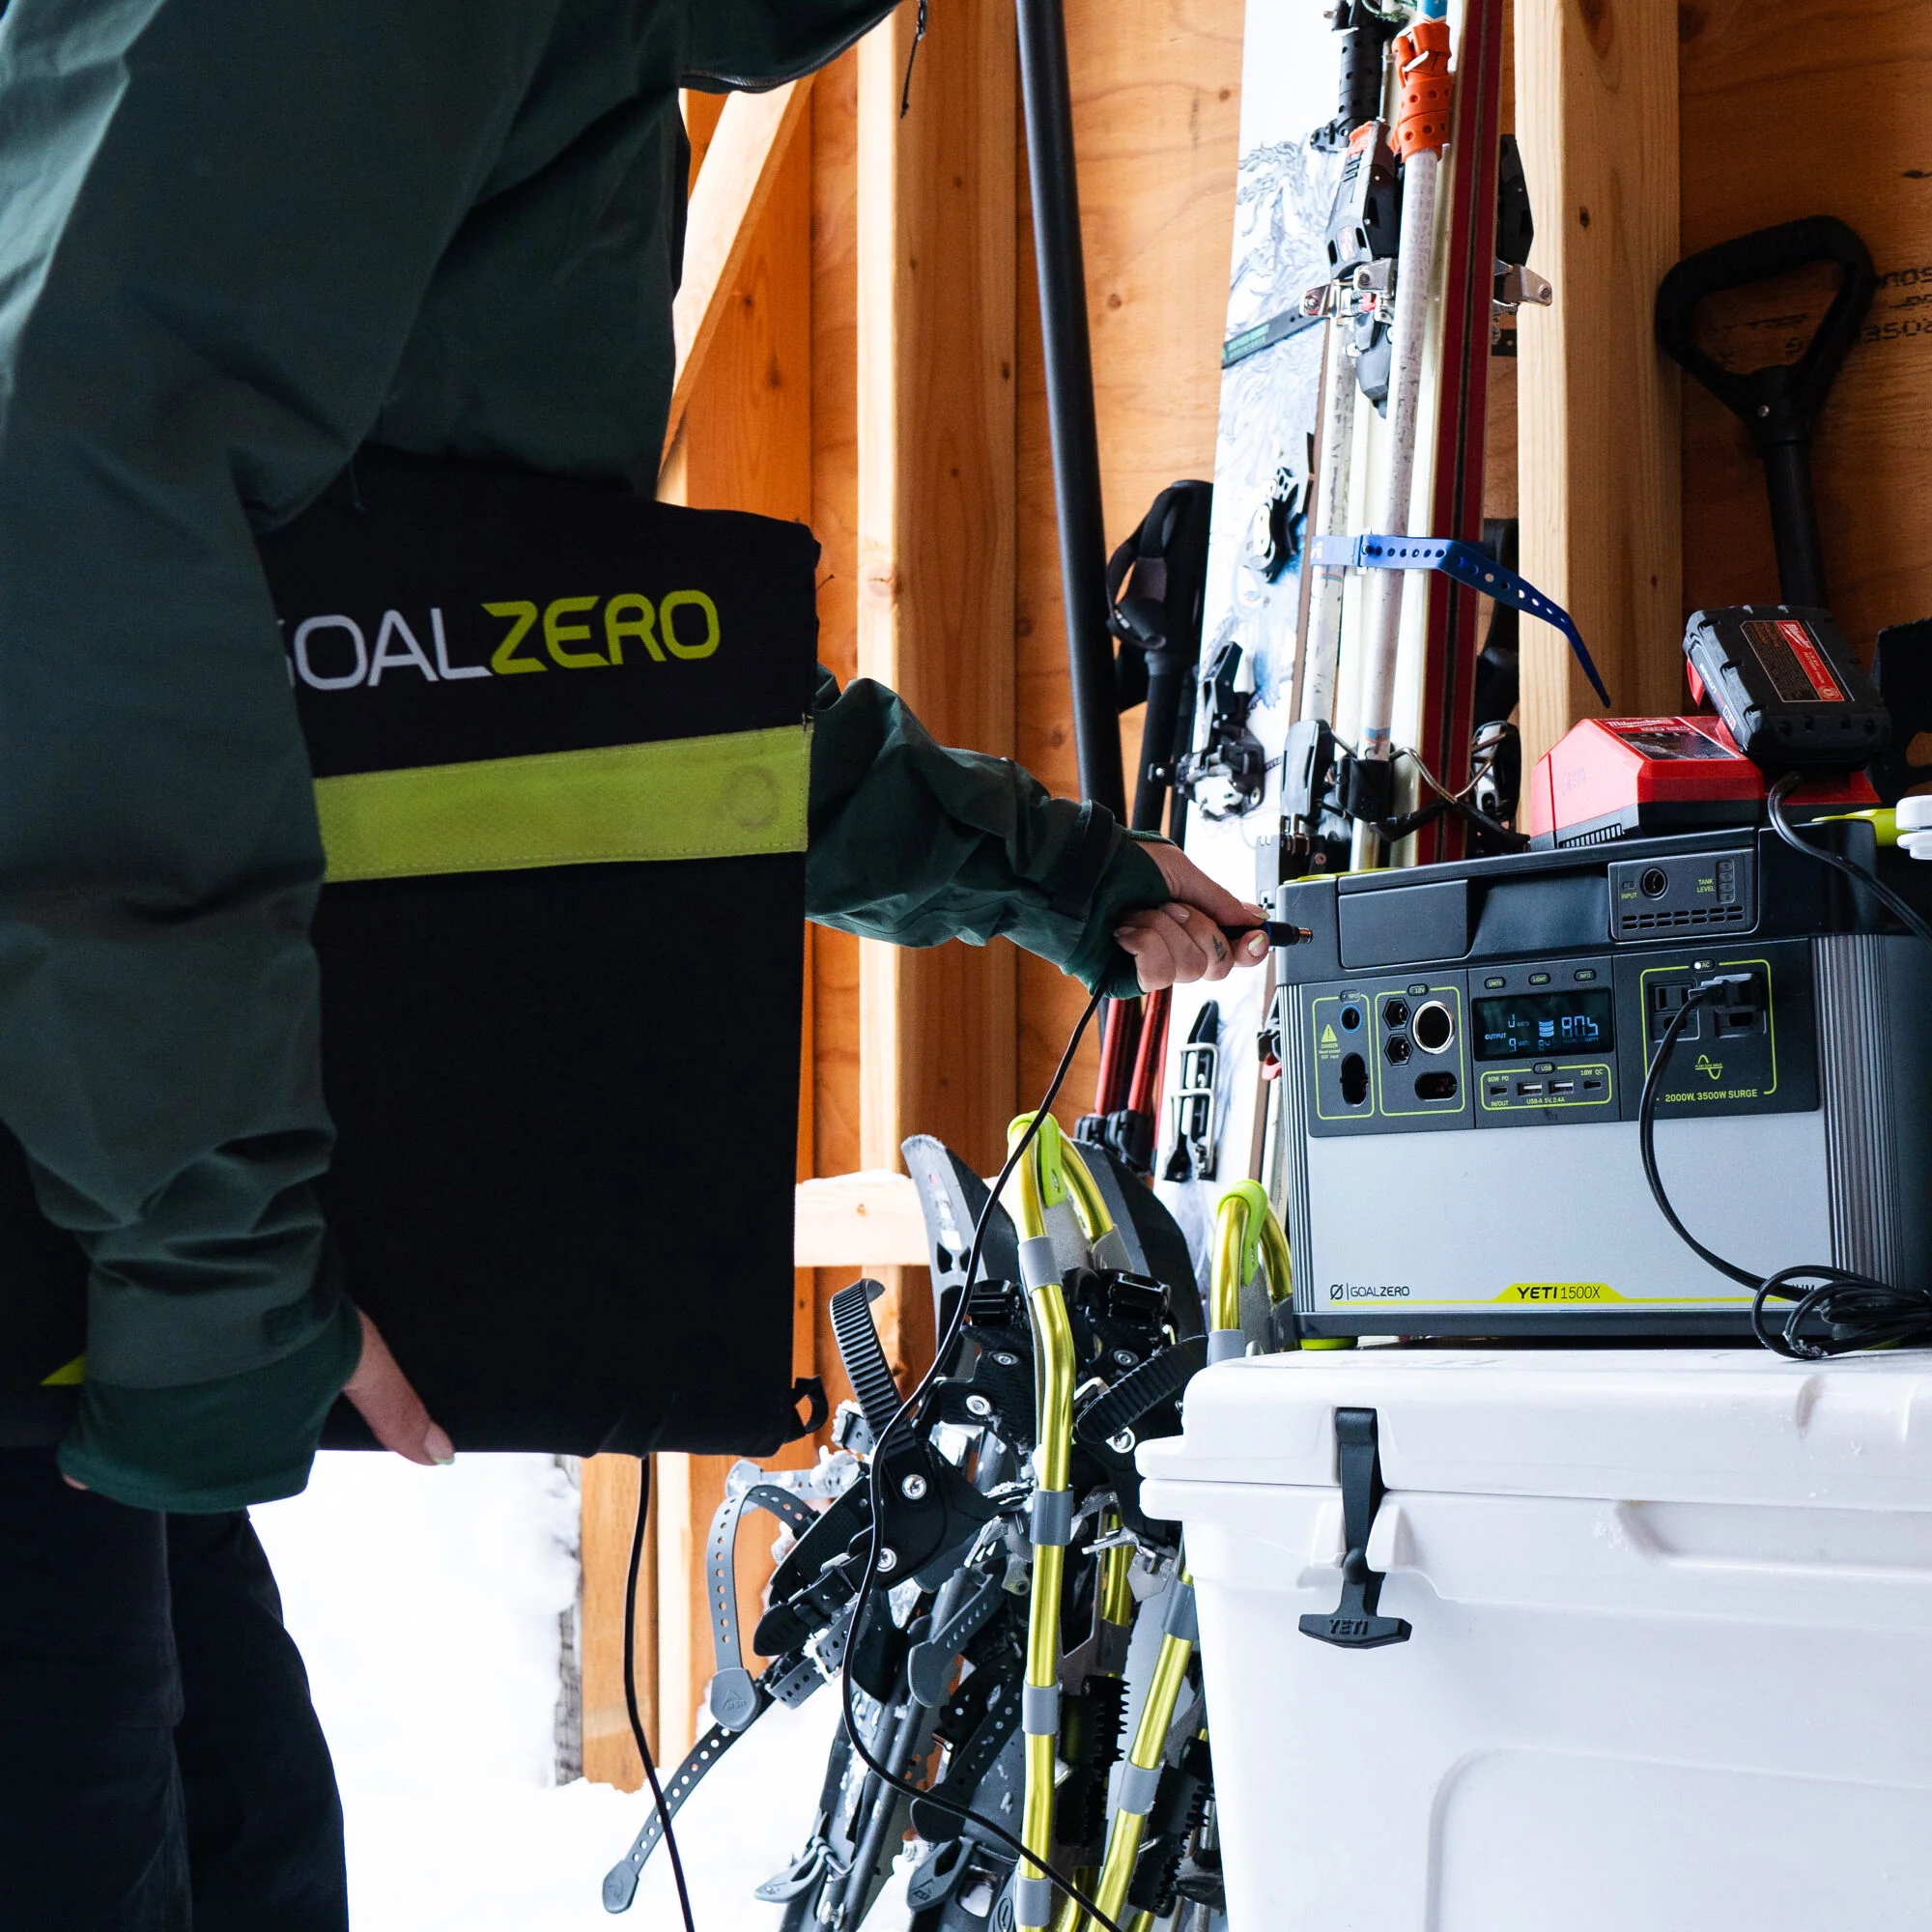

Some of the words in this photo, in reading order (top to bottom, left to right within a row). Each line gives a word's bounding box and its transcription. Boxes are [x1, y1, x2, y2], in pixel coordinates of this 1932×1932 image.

[275, 588, 721, 691] OALZERO
[1621, 892, 1637, 900] INPUT
[1697, 1091, 1726, 1101] 3500W
[1728, 1089, 1757, 1098] SURGE
[1350, 1286, 1410, 1297] GOALZERO
[1517, 1287, 1557, 1299] YETI
[1560, 1286, 1601, 1299] 1500X
[1328, 1618, 1369, 1635] YETI
